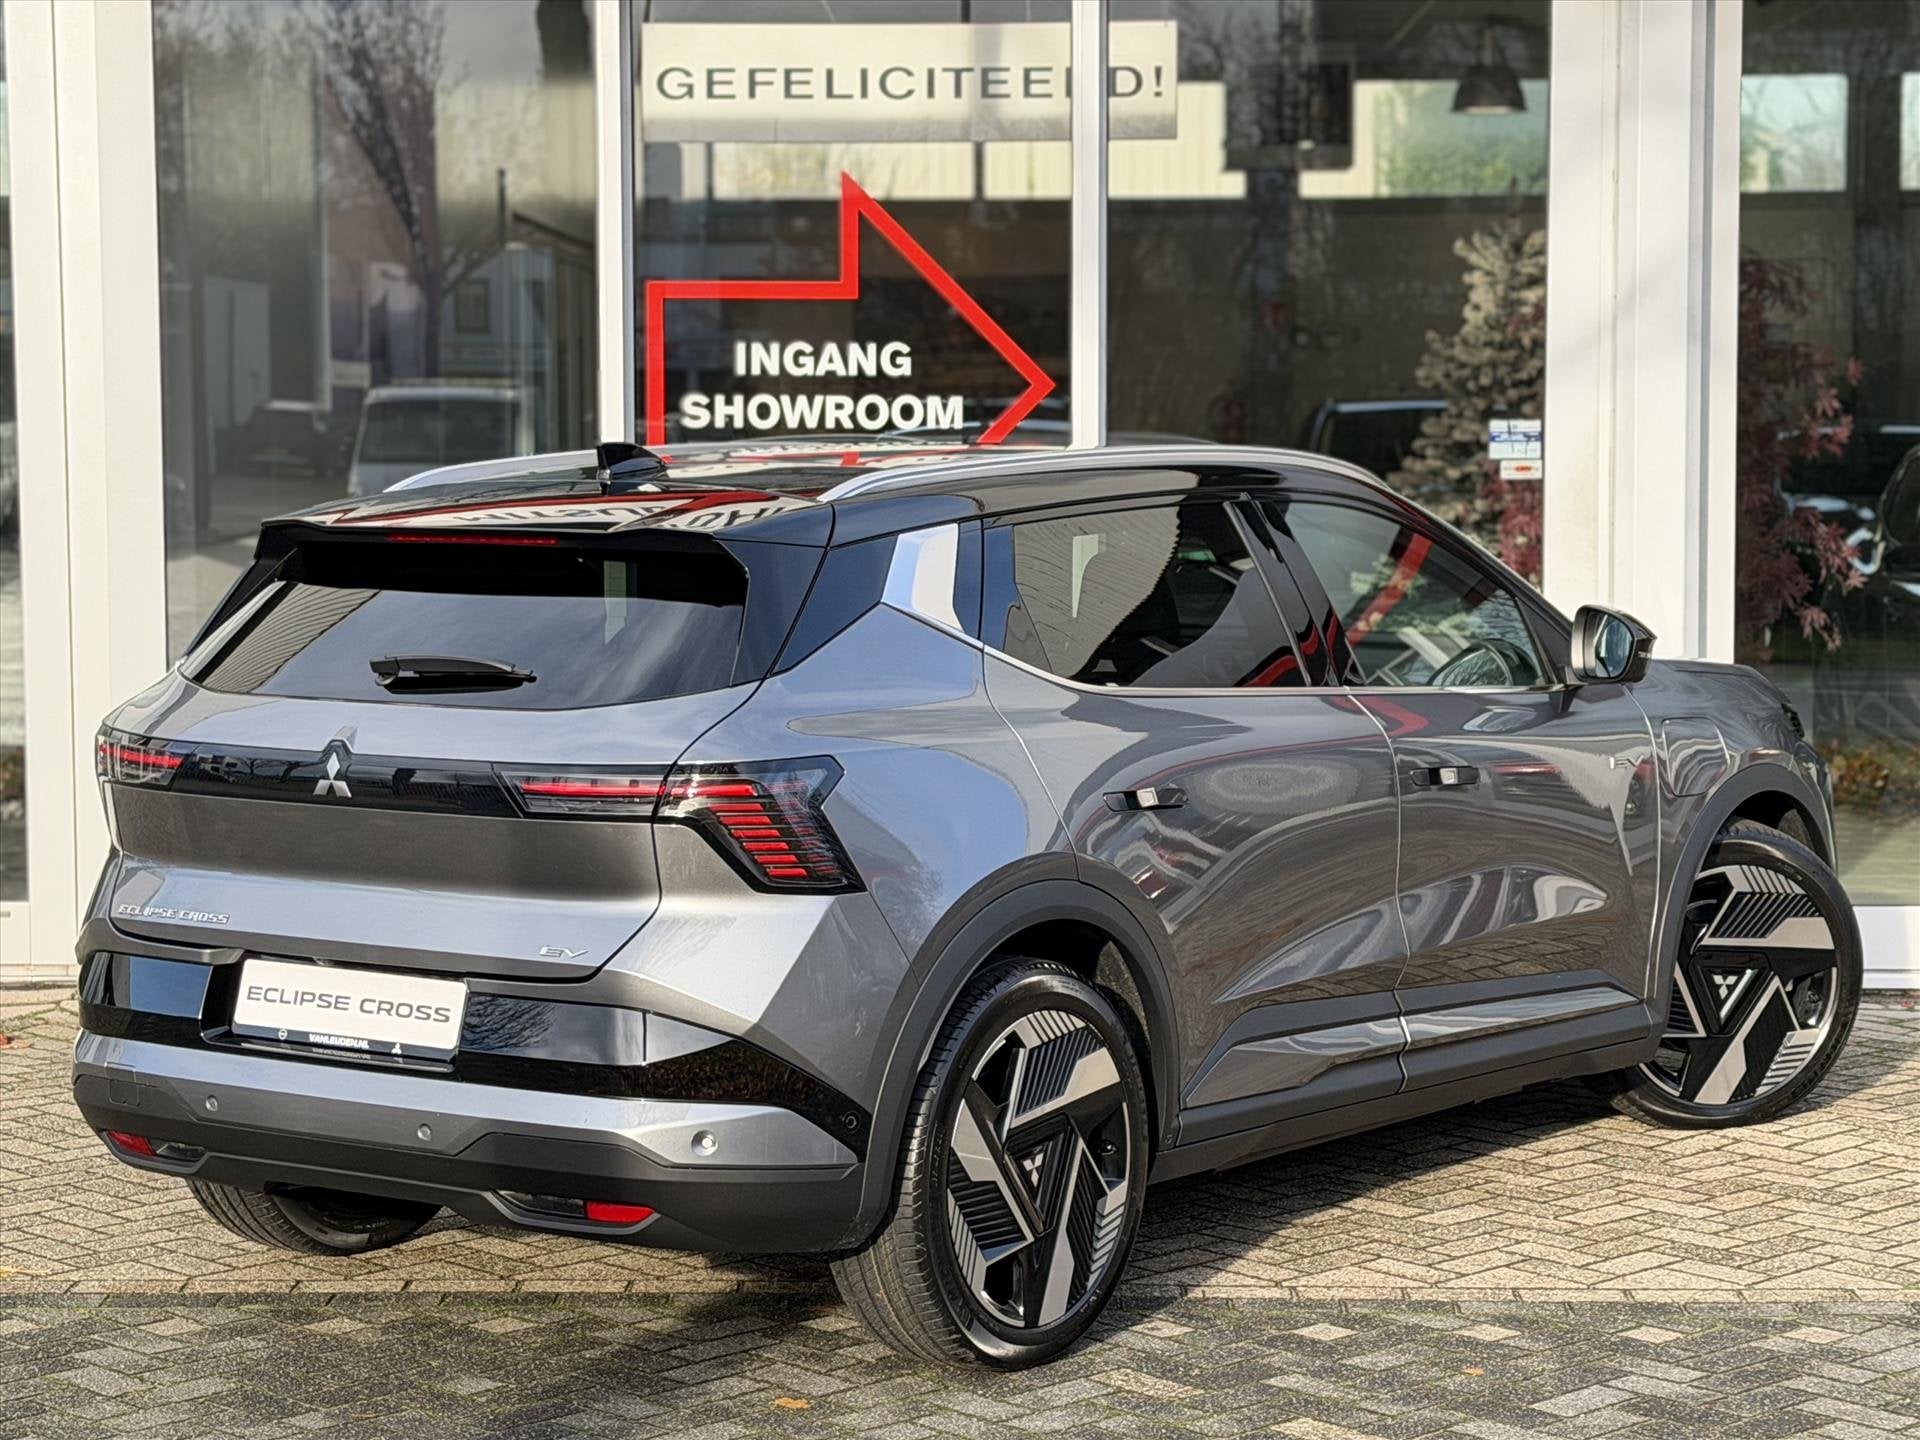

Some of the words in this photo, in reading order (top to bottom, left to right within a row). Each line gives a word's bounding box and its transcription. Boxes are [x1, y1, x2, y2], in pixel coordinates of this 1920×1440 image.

[656, 66, 1163, 99] GEFELICITEED!
[733, 340, 912, 377] INGANG
[680, 393, 965, 430] SHOWROOM
[119, 904, 177, 919] ECLIPSE
[179, 909, 230, 925] CROSS
[540, 946, 589, 959] EV
[247, 985, 351, 1011] ECLIPSE
[359, 997, 451, 1023] CROSS
